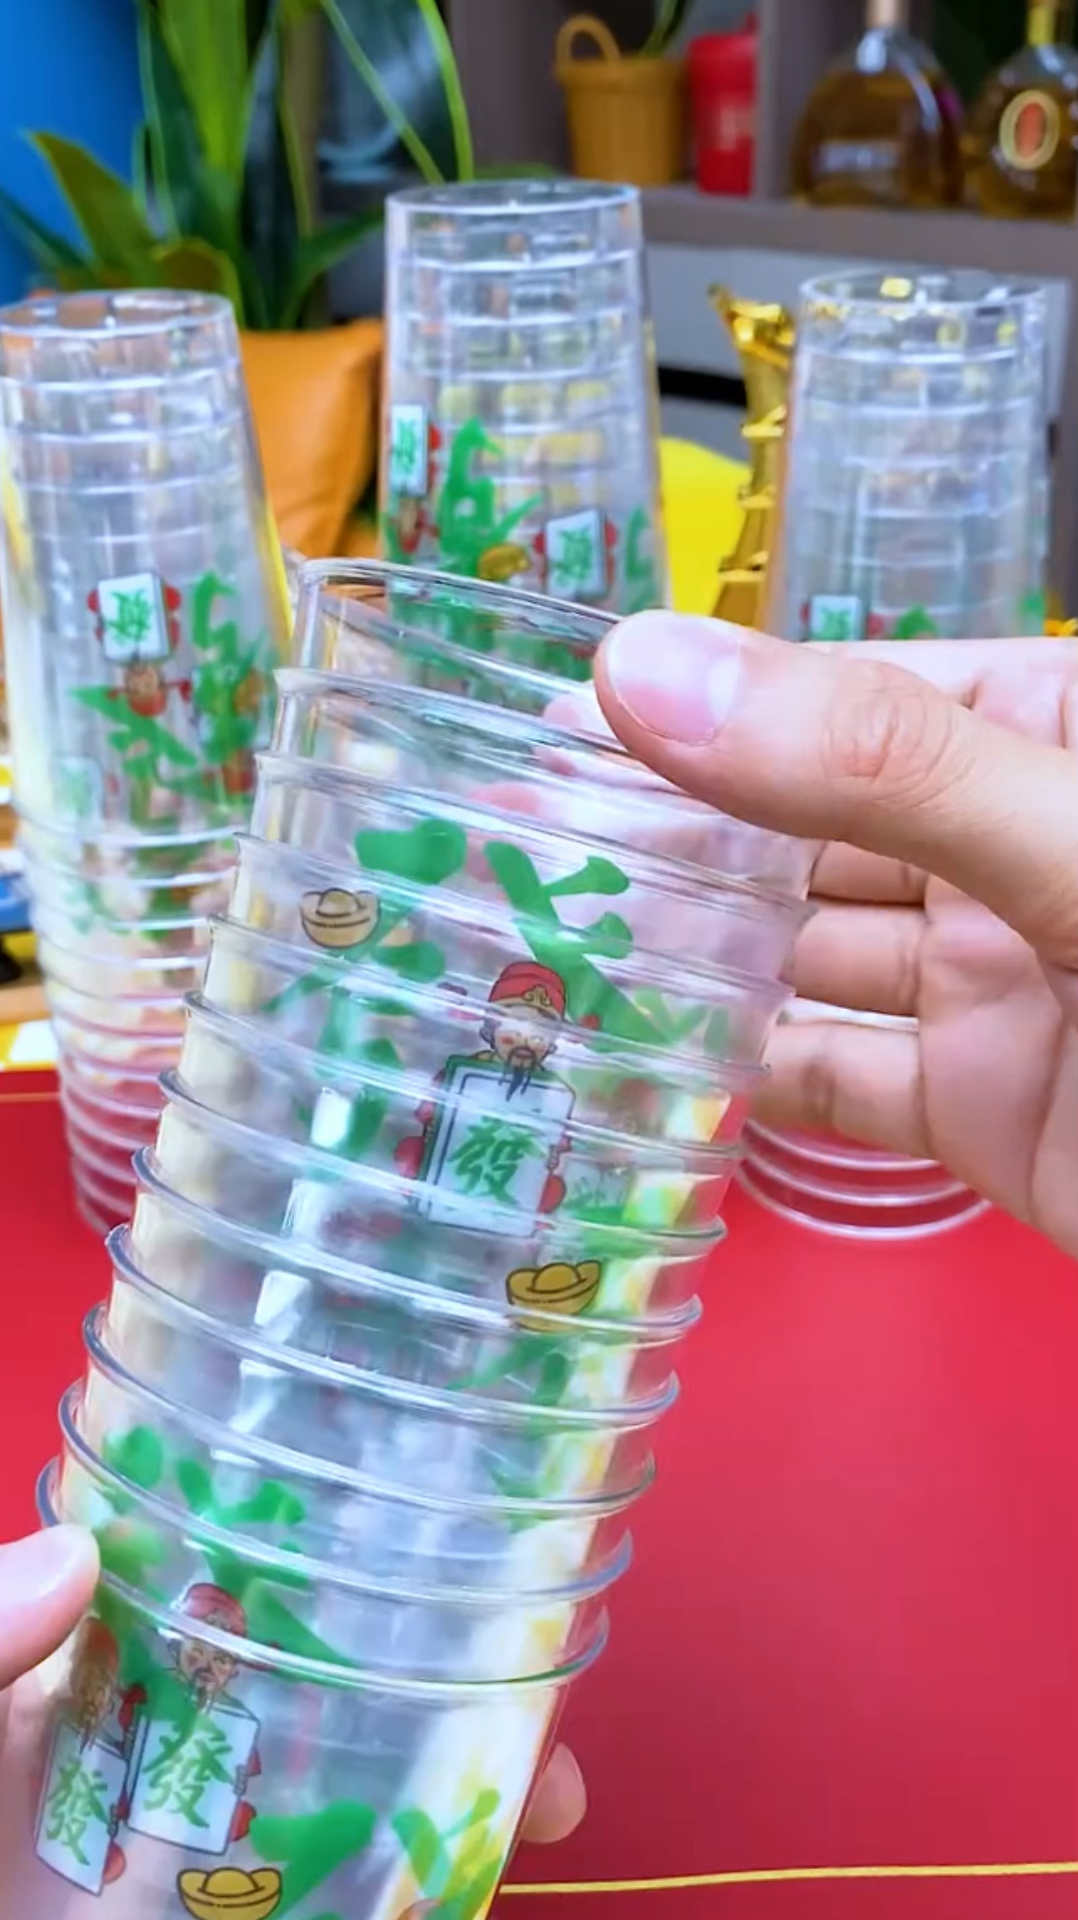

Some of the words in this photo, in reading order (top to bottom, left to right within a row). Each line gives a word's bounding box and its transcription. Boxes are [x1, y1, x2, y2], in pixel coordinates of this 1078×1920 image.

[447, 1114, 547, 1205] 發
[46, 1752, 111, 1867] 發
[143, 1712, 238, 1829] 發
